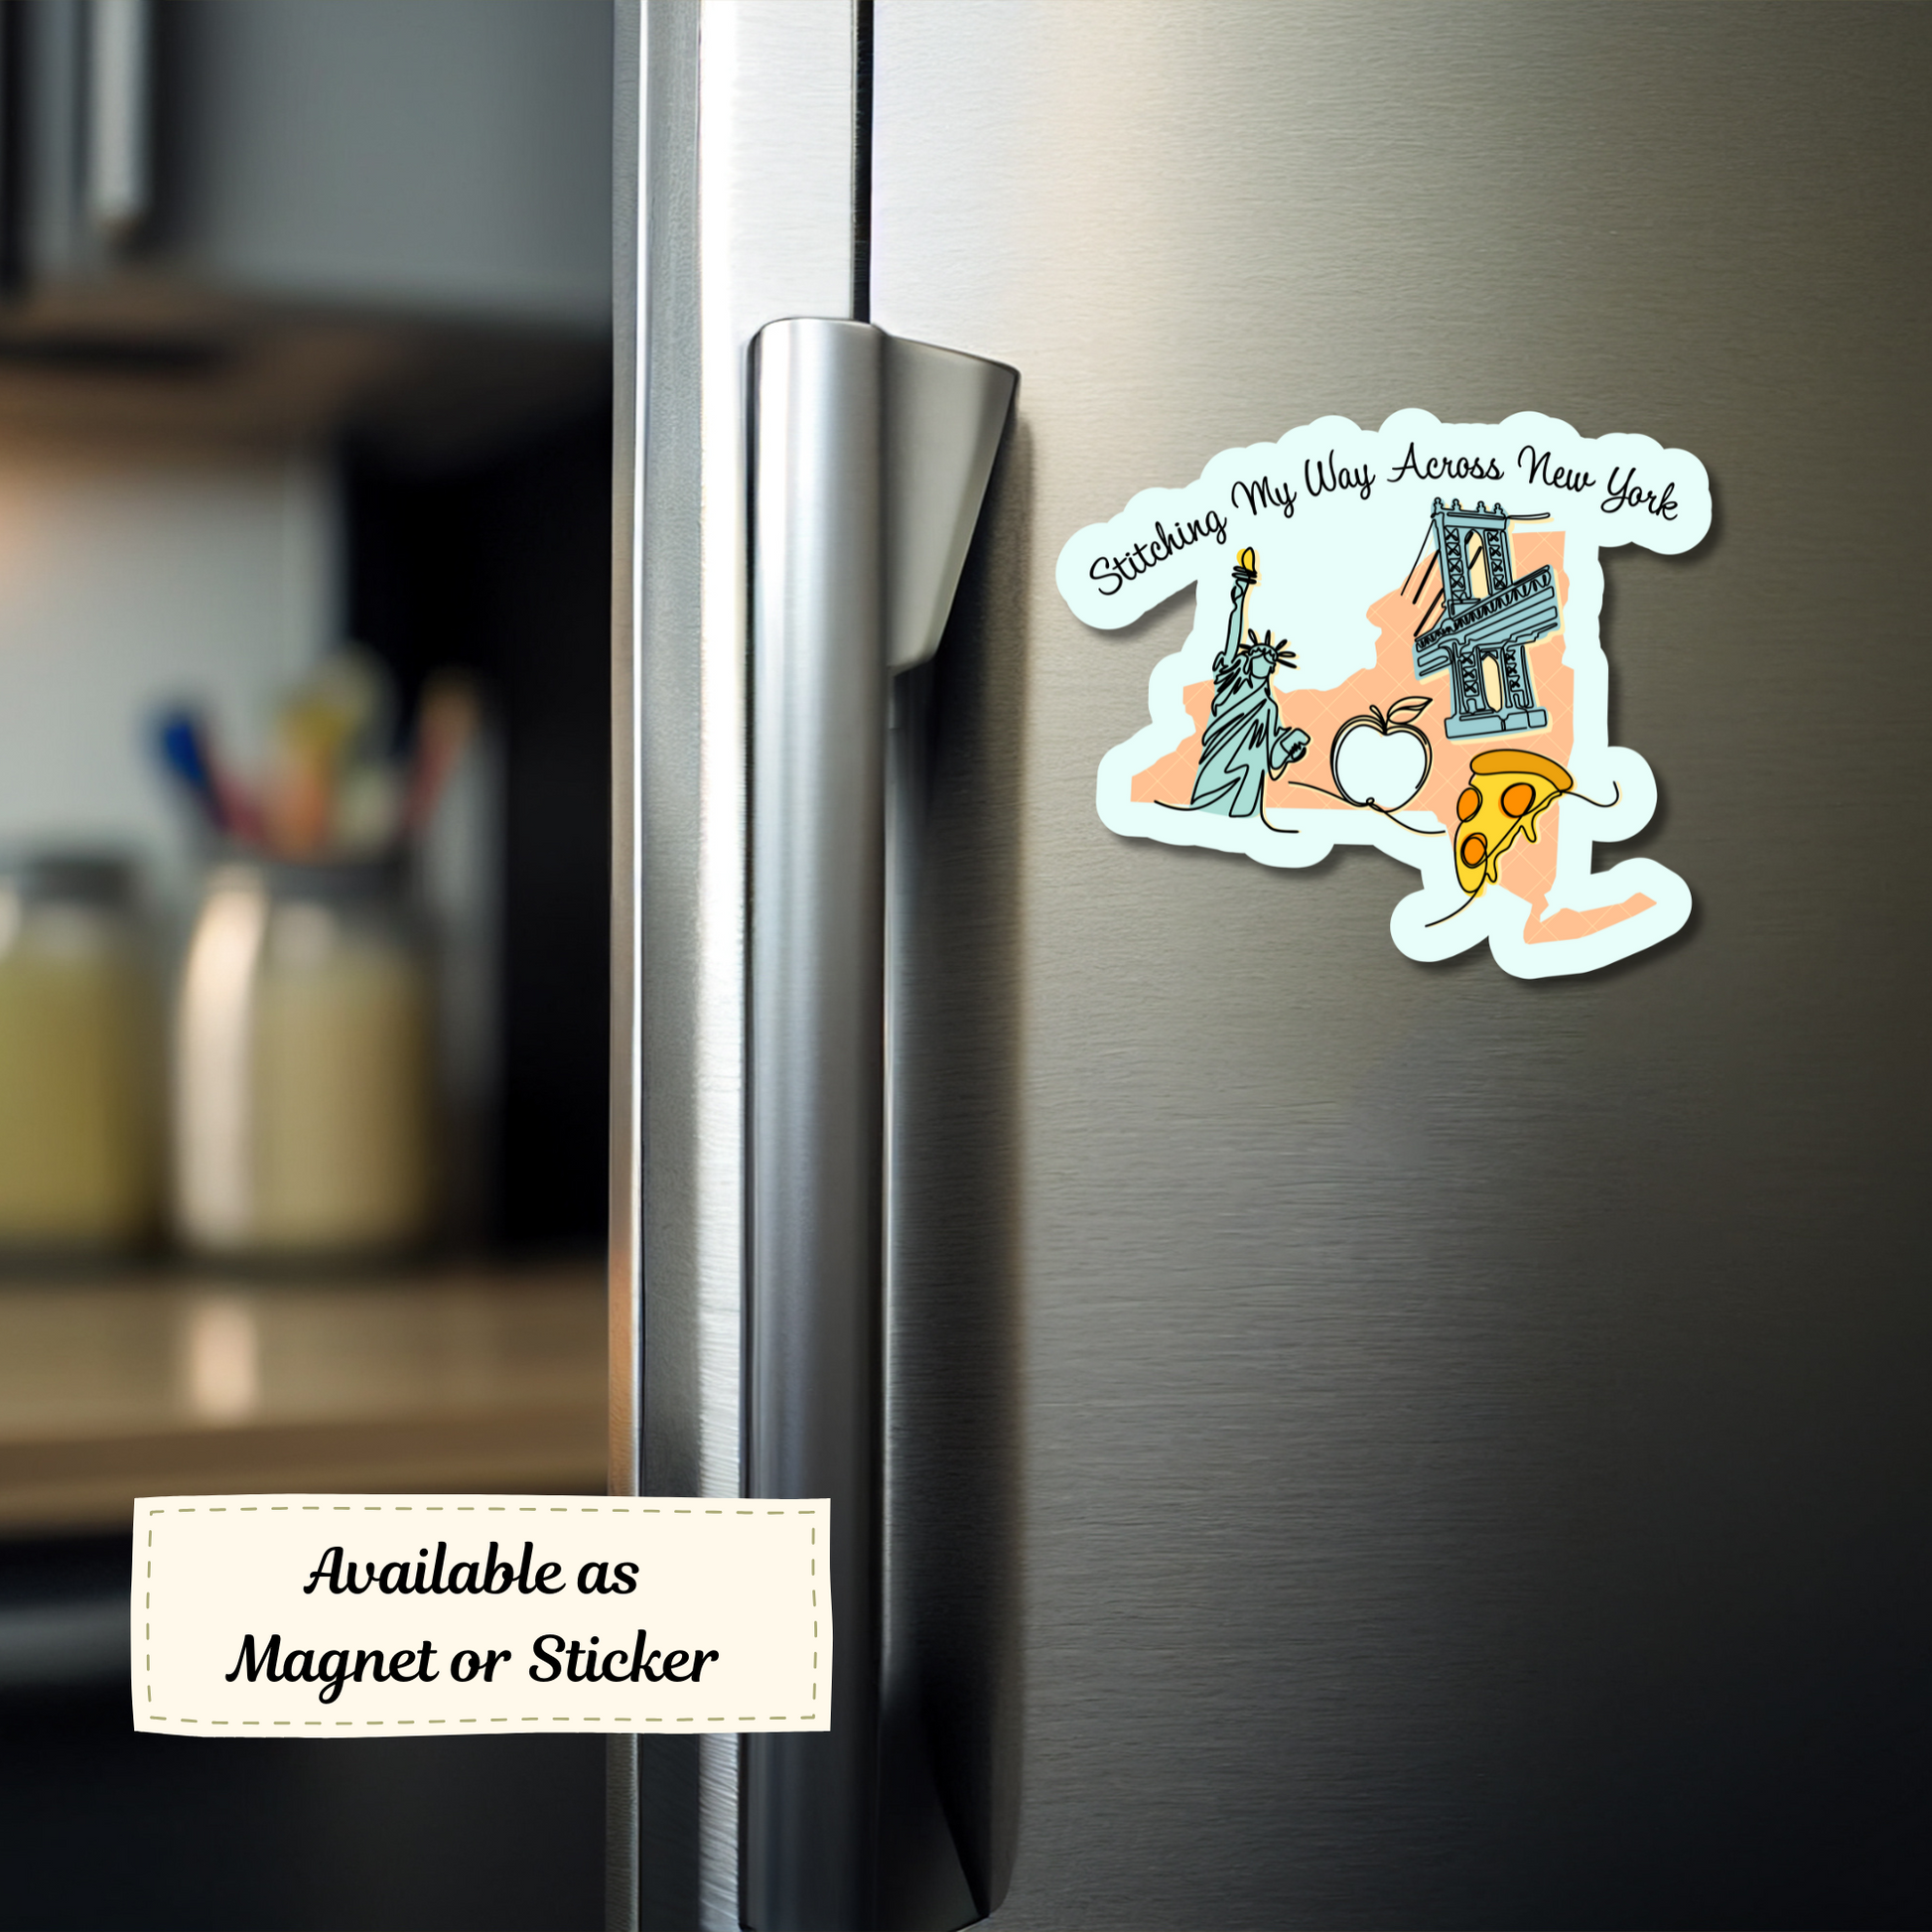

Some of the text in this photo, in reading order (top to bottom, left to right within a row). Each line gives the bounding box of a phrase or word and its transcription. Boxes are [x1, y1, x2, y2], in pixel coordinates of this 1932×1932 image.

[1089, 441, 1679, 596] Stitching My Way Across New York
